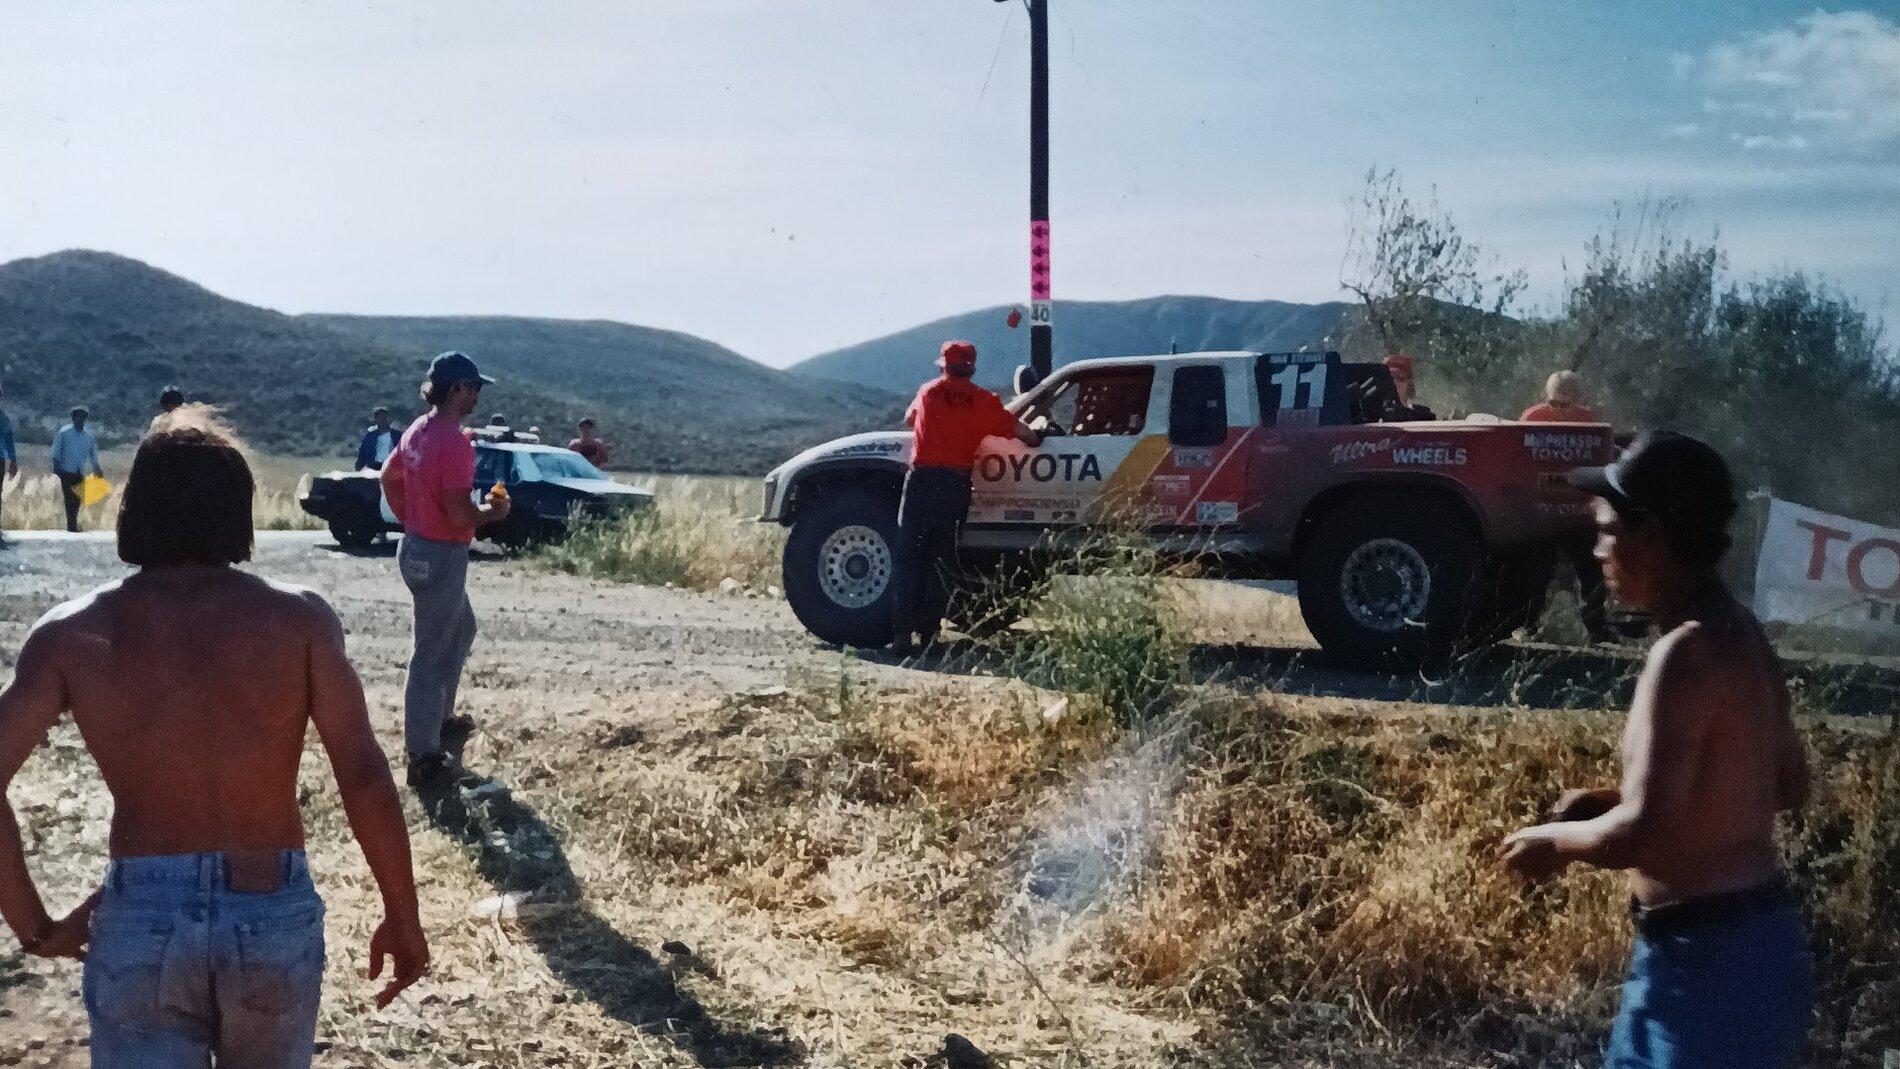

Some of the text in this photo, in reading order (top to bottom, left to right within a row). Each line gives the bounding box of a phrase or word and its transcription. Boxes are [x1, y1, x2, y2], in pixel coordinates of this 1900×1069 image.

[1270, 363, 1328, 409] 11
[973, 453, 1103, 482] OYOTA
[1392, 447, 1468, 465] WHEELS
[1796, 519, 1900, 599] TO
